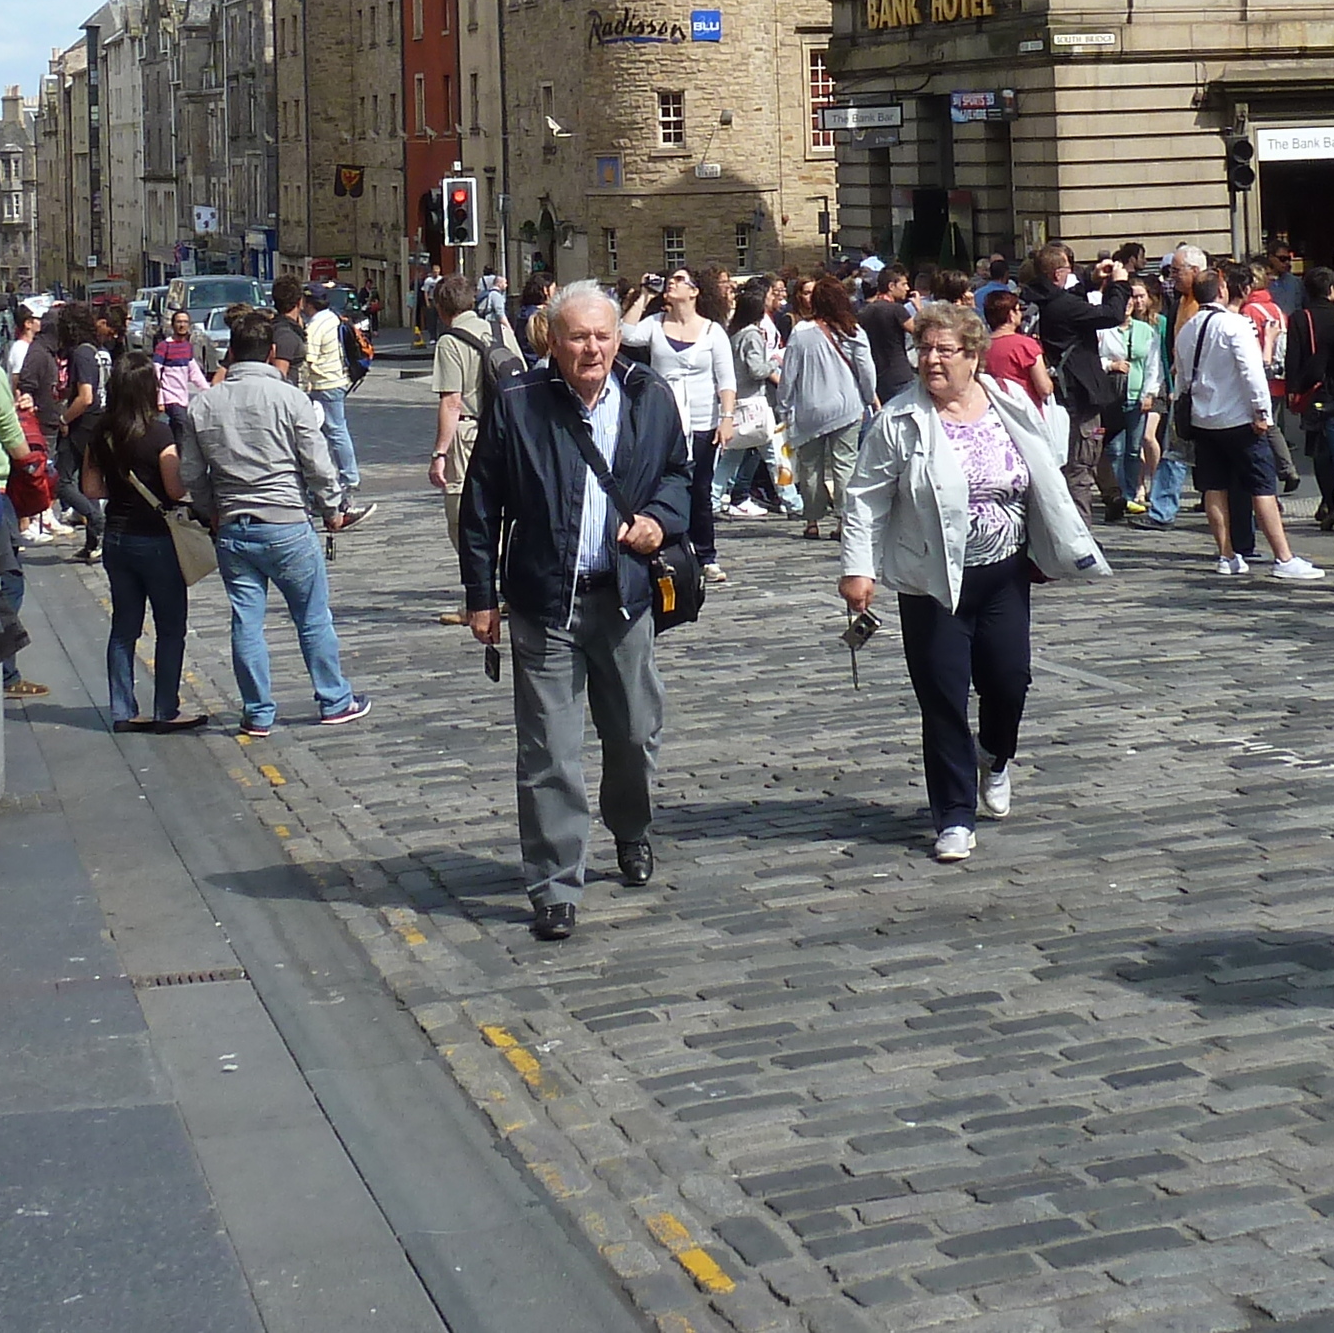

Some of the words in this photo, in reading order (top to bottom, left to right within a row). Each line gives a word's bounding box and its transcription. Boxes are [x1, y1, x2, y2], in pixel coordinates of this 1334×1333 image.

[587, 7, 687, 51] Radisson
[693, 20, 720, 32] BLU
[1056, 35, 1082, 44] SOUTH
[1085, 34, 1112, 43] BRIDGE
[832, 113, 848, 124] The
[852, 112, 876, 123] Bank
[877, 111, 894, 123] Bar
[1267, 138, 1289, 150] The
[1292, 137, 1320, 149] Bank
